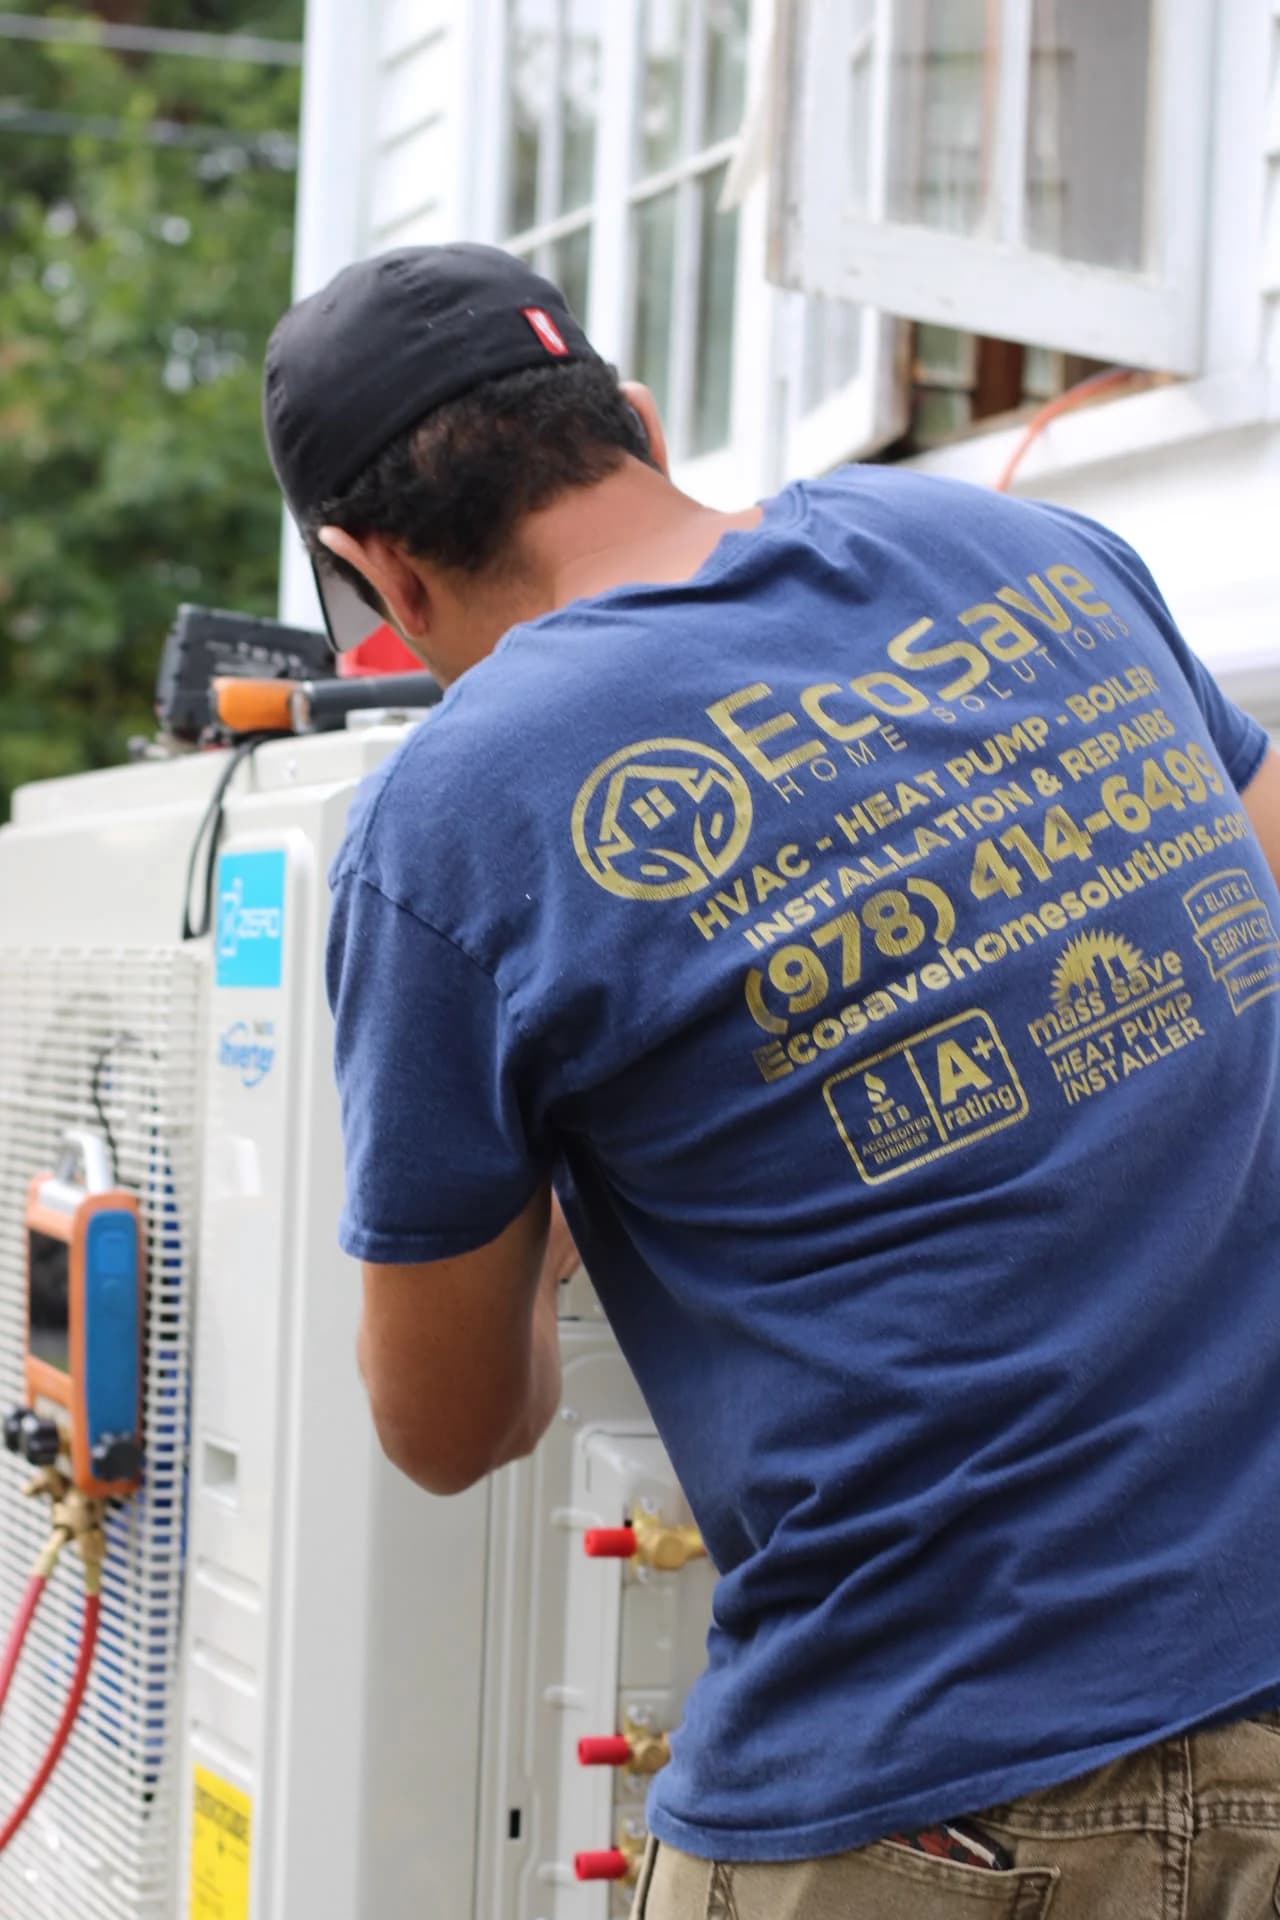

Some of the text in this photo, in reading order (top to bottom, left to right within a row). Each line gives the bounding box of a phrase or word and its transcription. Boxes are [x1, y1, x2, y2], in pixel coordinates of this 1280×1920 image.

[705, 563, 1112, 783] EcoSave
[772, 613, 1130, 803] HOME SOLUTIONS
[689, 843, 811, 940] HVAC
[833, 769, 947, 845] HEAT
[944, 715, 1049, 788] PUMP
[1065, 664, 1161, 724] BOILER
[743, 707, 1176, 951] INSTALLATION & REPAIRS
[744, 742, 1225, 1034] (978) 414-6499
[1203, 882, 1244, 913] ELITE
[1210, 916, 1271, 960] SERVICE
[1027, 991, 1106, 1047] mass
[1110, 950, 1182, 1004] save
[1051, 992, 1193, 1082] HEAT PUMP
[1061, 1016, 1205, 1106] INSTALLER
[862, 1115, 932, 1156] ACCREDITED
[873, 1133, 929, 1166] BUSINESS
[943, 1084, 1017, 1132] rating
